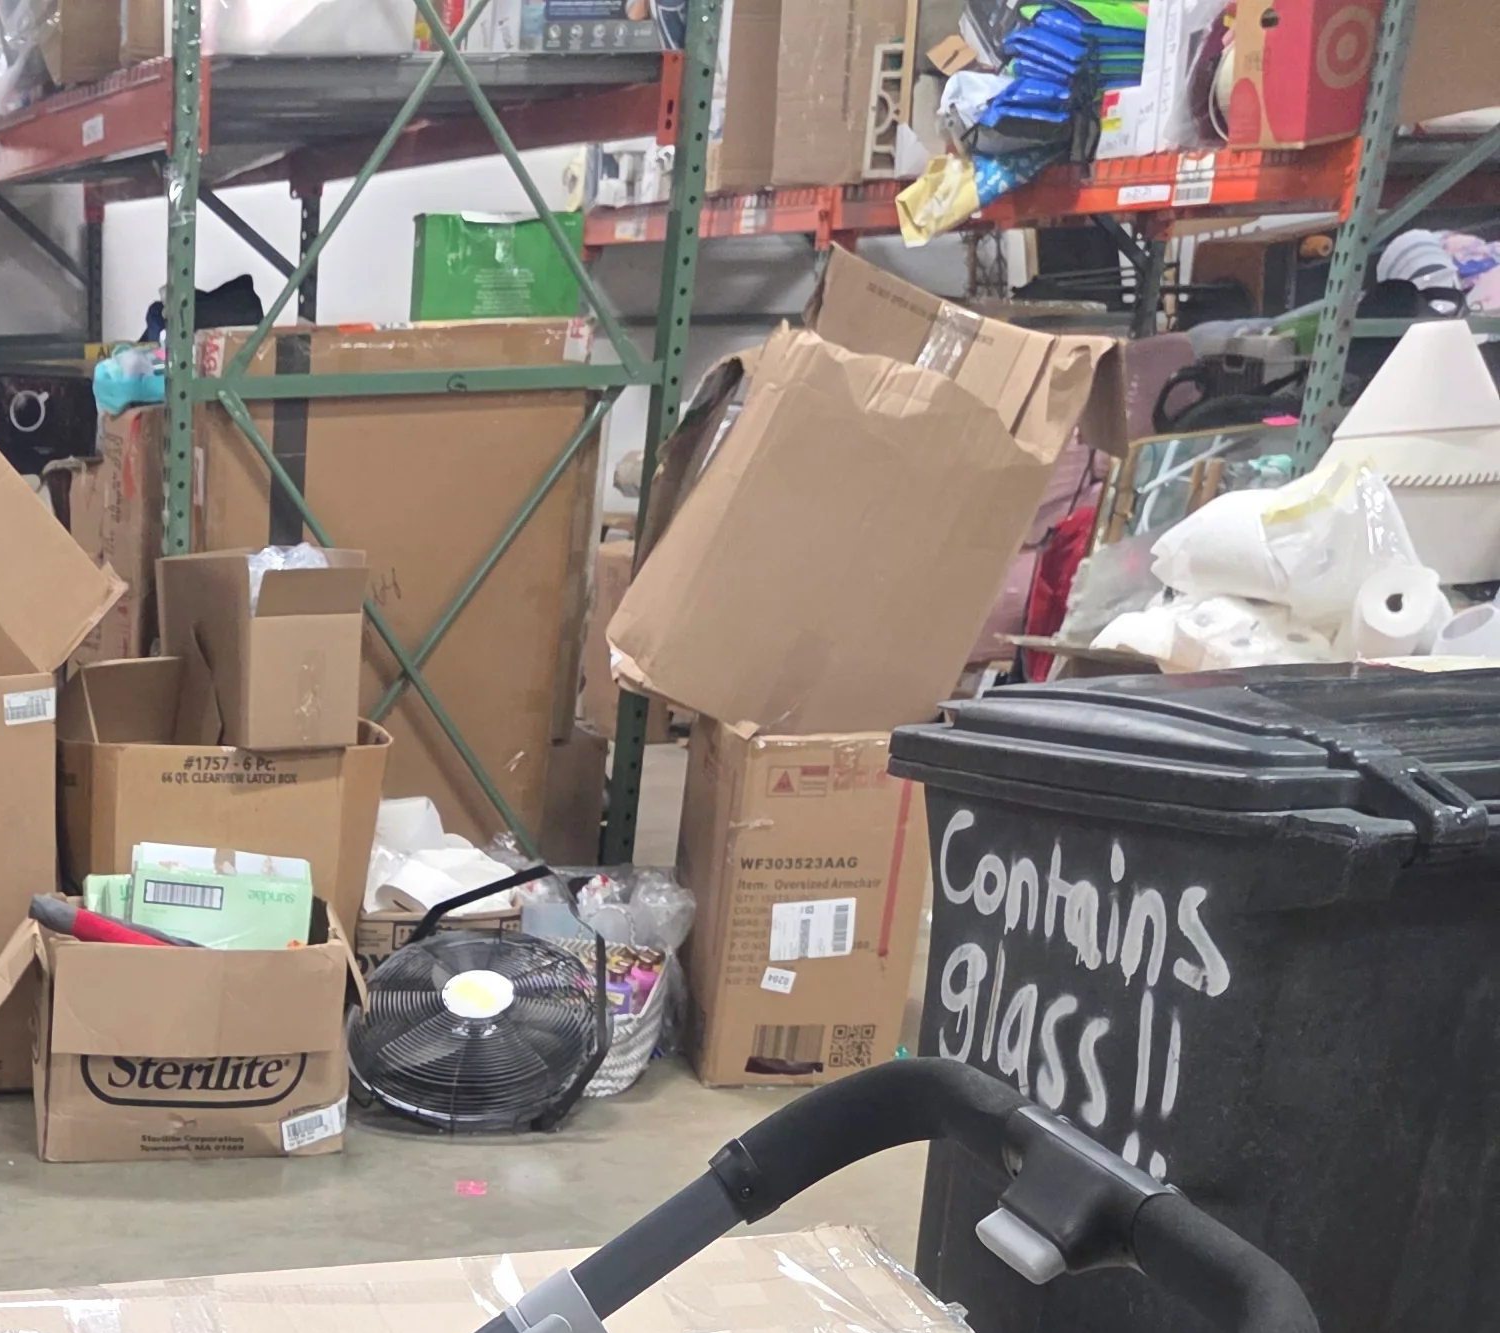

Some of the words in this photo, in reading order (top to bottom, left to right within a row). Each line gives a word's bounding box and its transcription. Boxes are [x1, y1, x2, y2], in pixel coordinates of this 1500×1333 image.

[183, 756, 229, 770] #1757
[242, 756, 251, 770] 6
[256, 756, 276, 771] Pc.
[191, 773, 244, 784] CLEARVIEW
[246, 773, 275, 784] LATCH
[278, 774, 298, 783] BOX
[740, 857, 858, 870] WF303523AAG
[774, 878, 829, 890] Oversized
[830, 878, 881, 890] Armchair
[940, 809, 1230, 997] Contains
[107, 1055, 283, 1091] Sterilite
